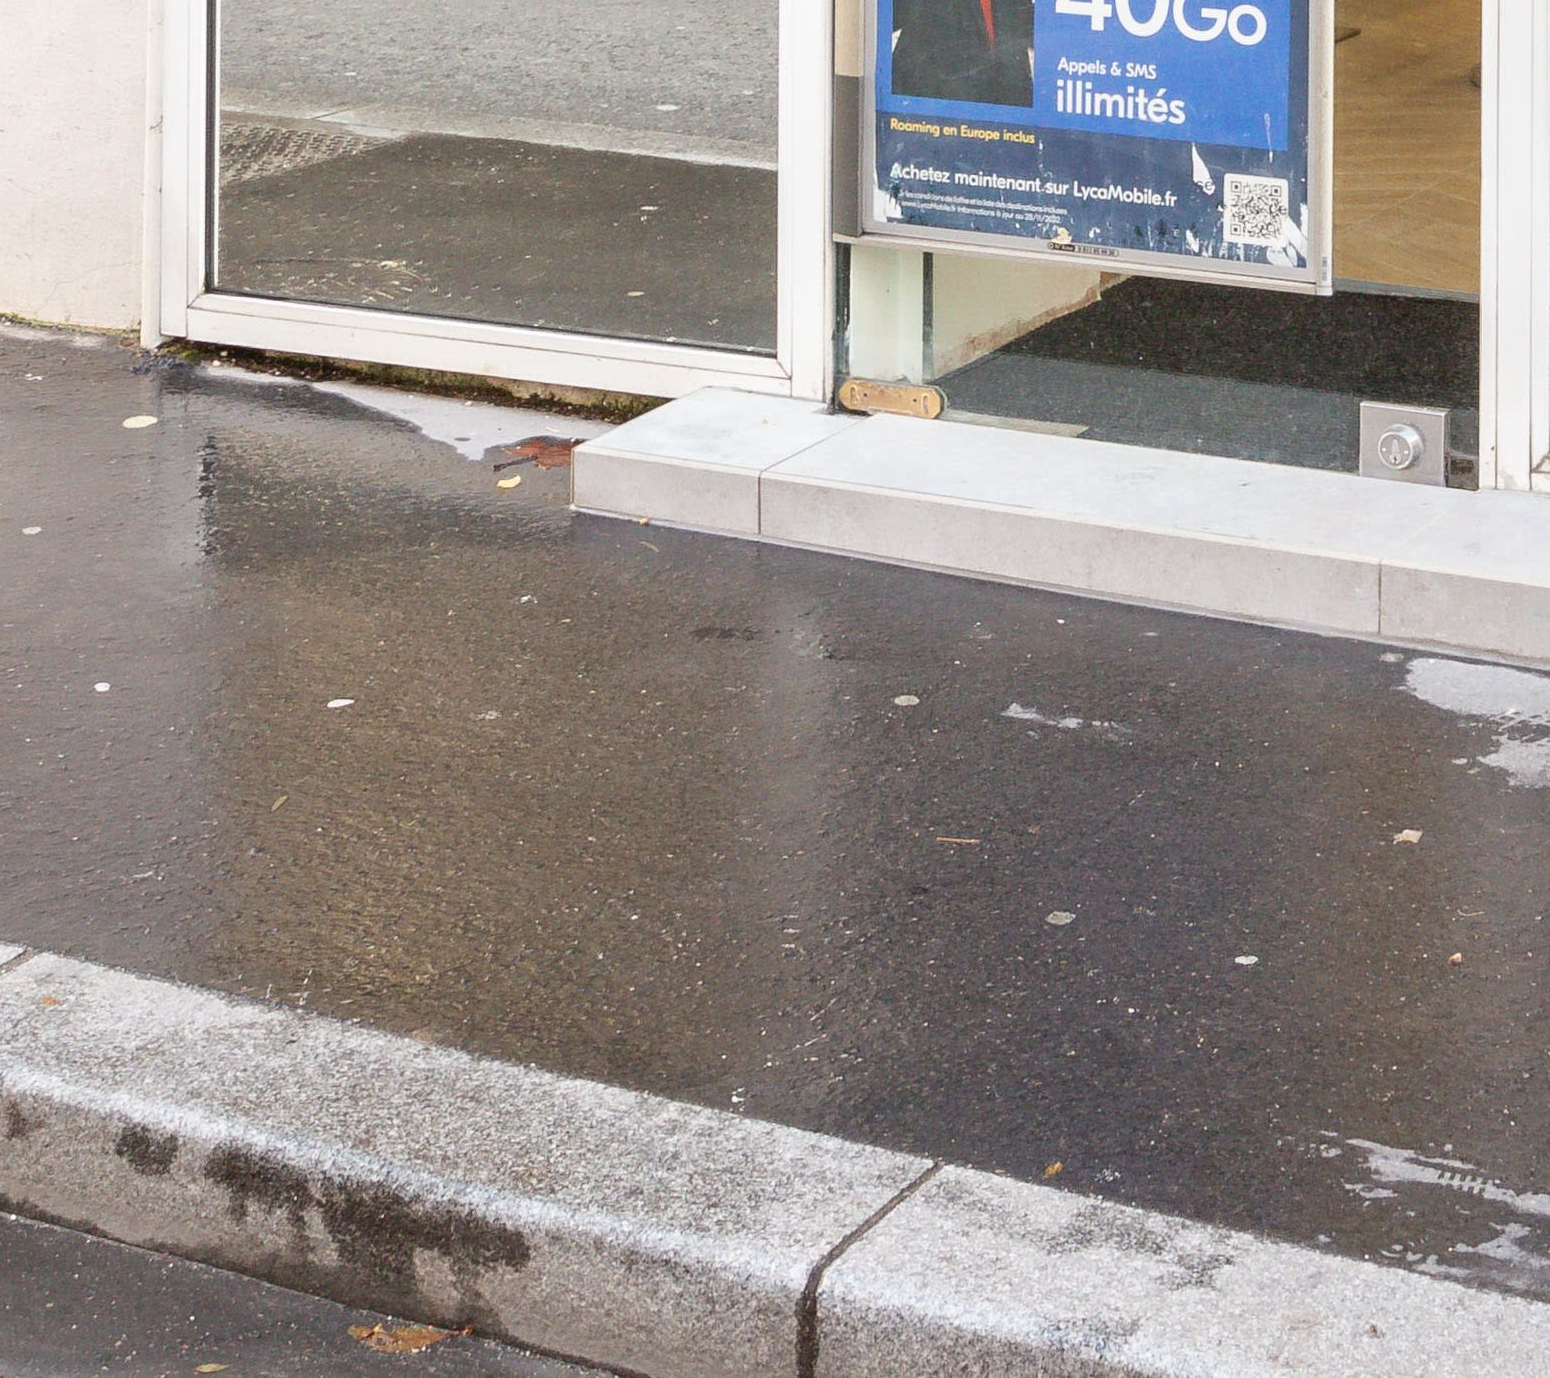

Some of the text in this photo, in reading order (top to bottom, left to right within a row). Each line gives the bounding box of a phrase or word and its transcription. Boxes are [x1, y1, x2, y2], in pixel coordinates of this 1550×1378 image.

[1057, 57, 1156, 79] Appels & SMS
[1057, 80, 1186, 125] illimités
[890, 118, 1035, 143] Roaming en Europe inclus
[890, 162, 950, 183] Achetez
[954, 171, 1040, 192] maintenant
[1044, 184, 1069, 195] sur
[1073, 181, 1177, 207] LycaMobile.fr
